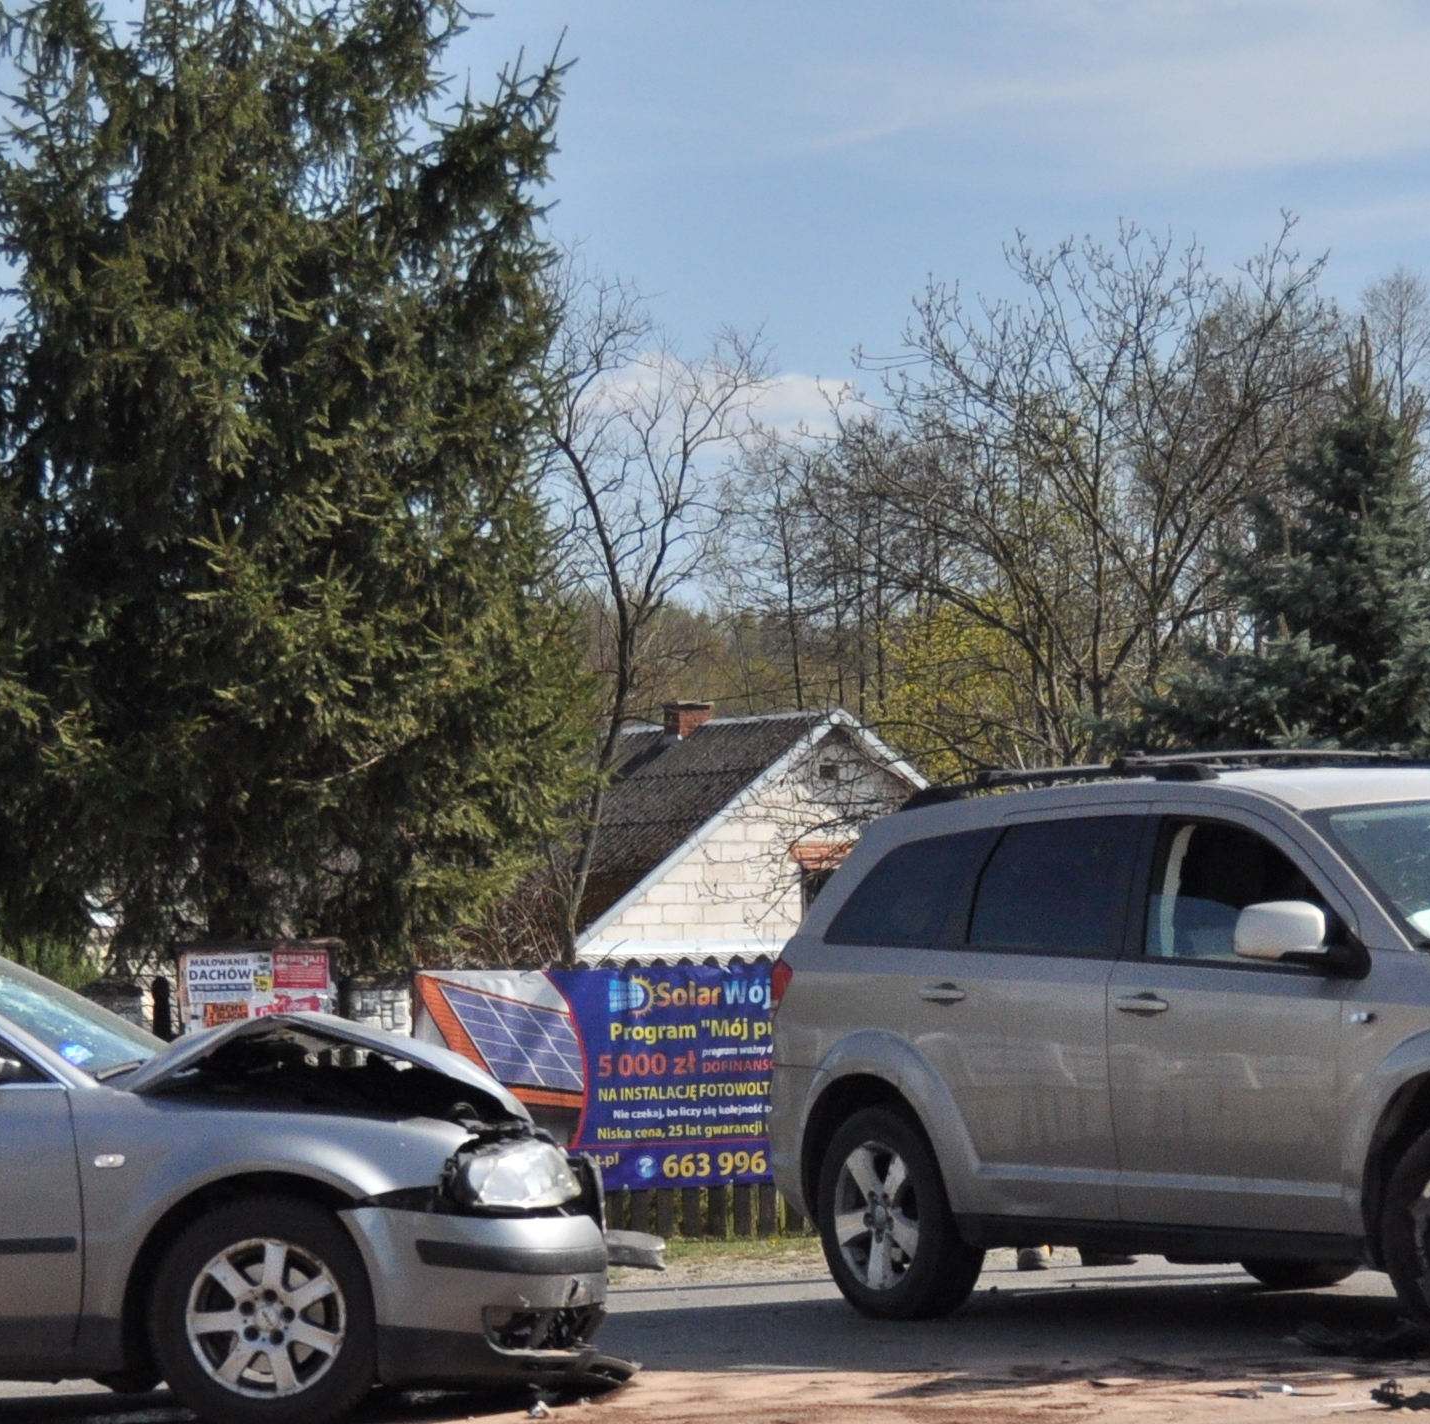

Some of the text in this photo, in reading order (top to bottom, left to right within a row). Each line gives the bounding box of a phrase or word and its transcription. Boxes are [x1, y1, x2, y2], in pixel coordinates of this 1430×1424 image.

[190, 958, 249, 967] MALOWANIE
[189, 968, 251, 981] DACHÓW
[610, 1022, 697, 1045] Program
[702, 1047, 738, 1059] program
[598, 1050, 696, 1077] 5 000 zł
[598, 1081, 772, 1102] NA INSTALACJĘ FOTOWOLT
[613, 1109, 630, 1119] Nie
[631, 1107, 665, 1119] czekaj,
[666, 1108, 678, 1117] bo
[680, 1106, 700, 1119] liczy
[703, 1105, 717, 1117] się
[597, 1127, 631, 1140] Niska
[634, 1128, 666, 1139] cena,
[668, 1125, 683, 1137] 25
[685, 1124, 702, 1136] lat
[705, 1121, 762, 1138] gwarancji
[663, 1152, 711, 1178] 663
[718, 1150, 767, 1176] 996
